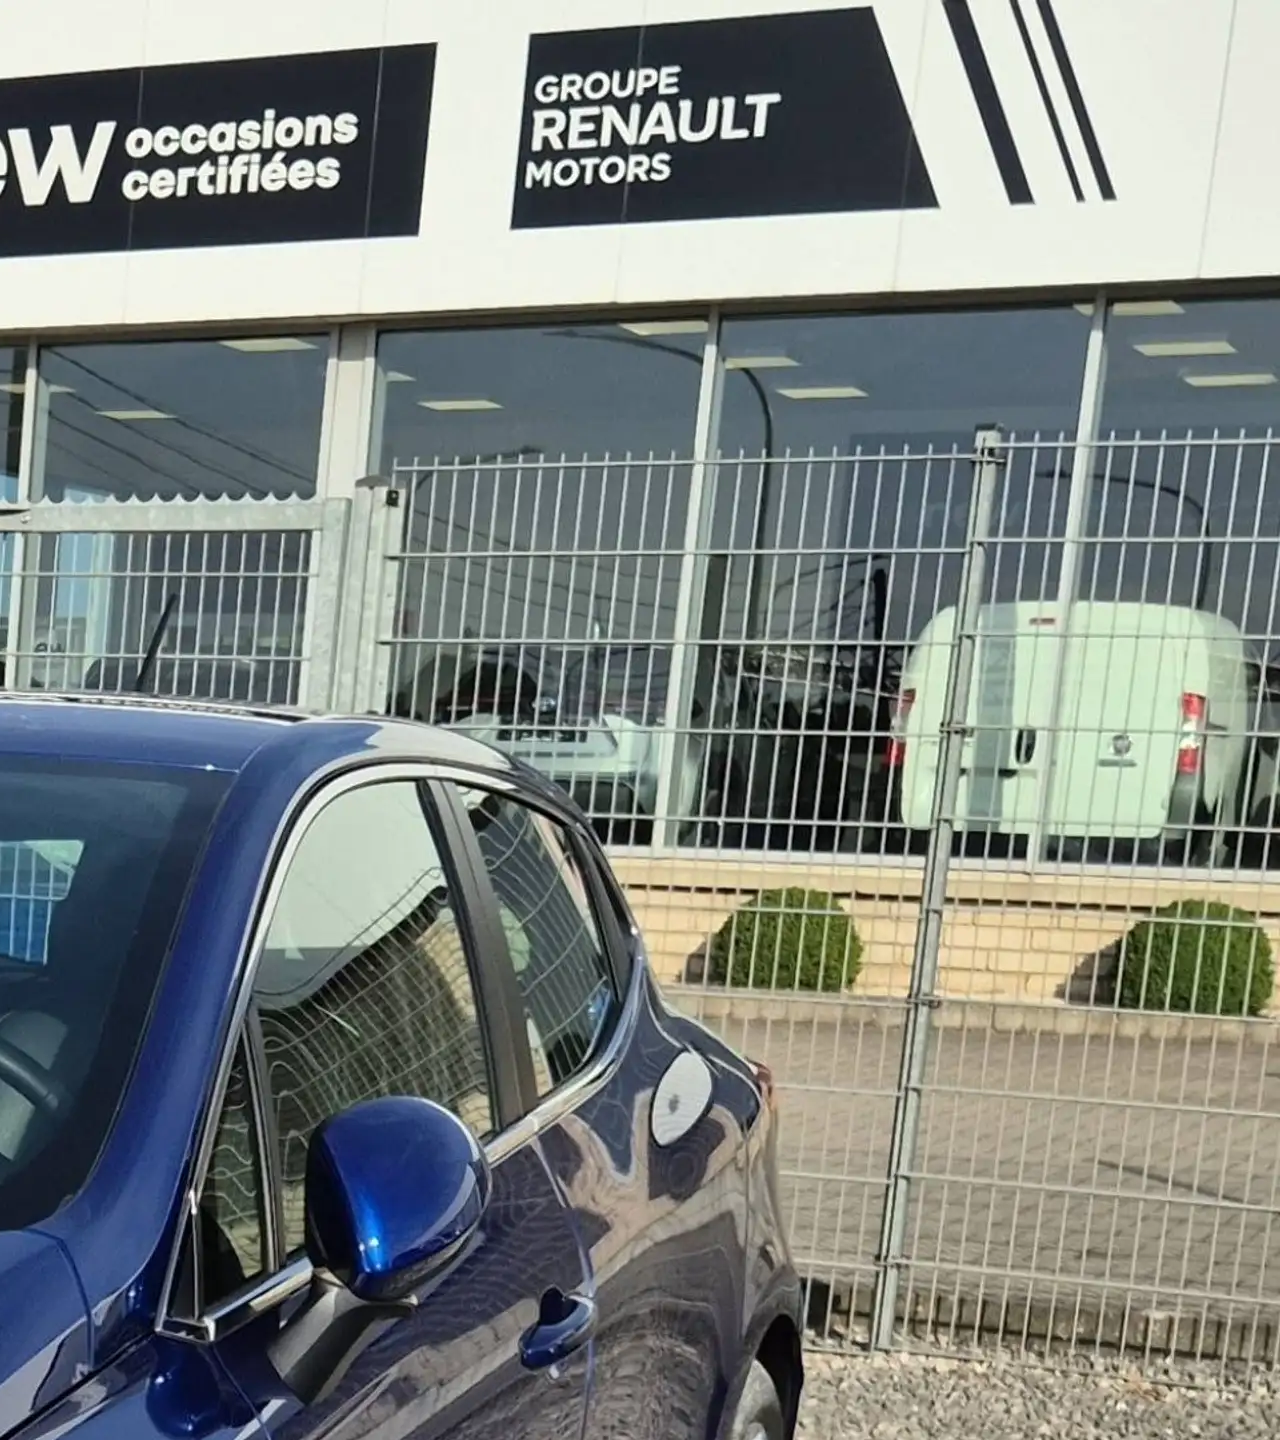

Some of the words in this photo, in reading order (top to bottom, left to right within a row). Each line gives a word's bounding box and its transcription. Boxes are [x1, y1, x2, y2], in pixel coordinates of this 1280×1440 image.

[534, 65, 682, 105] GROUPE
[125, 108, 359, 159] occasions
[530, 92, 781, 152] RENAULT
[122, 150, 341, 202] certifiées
[524, 153, 671, 190] MOTORS
